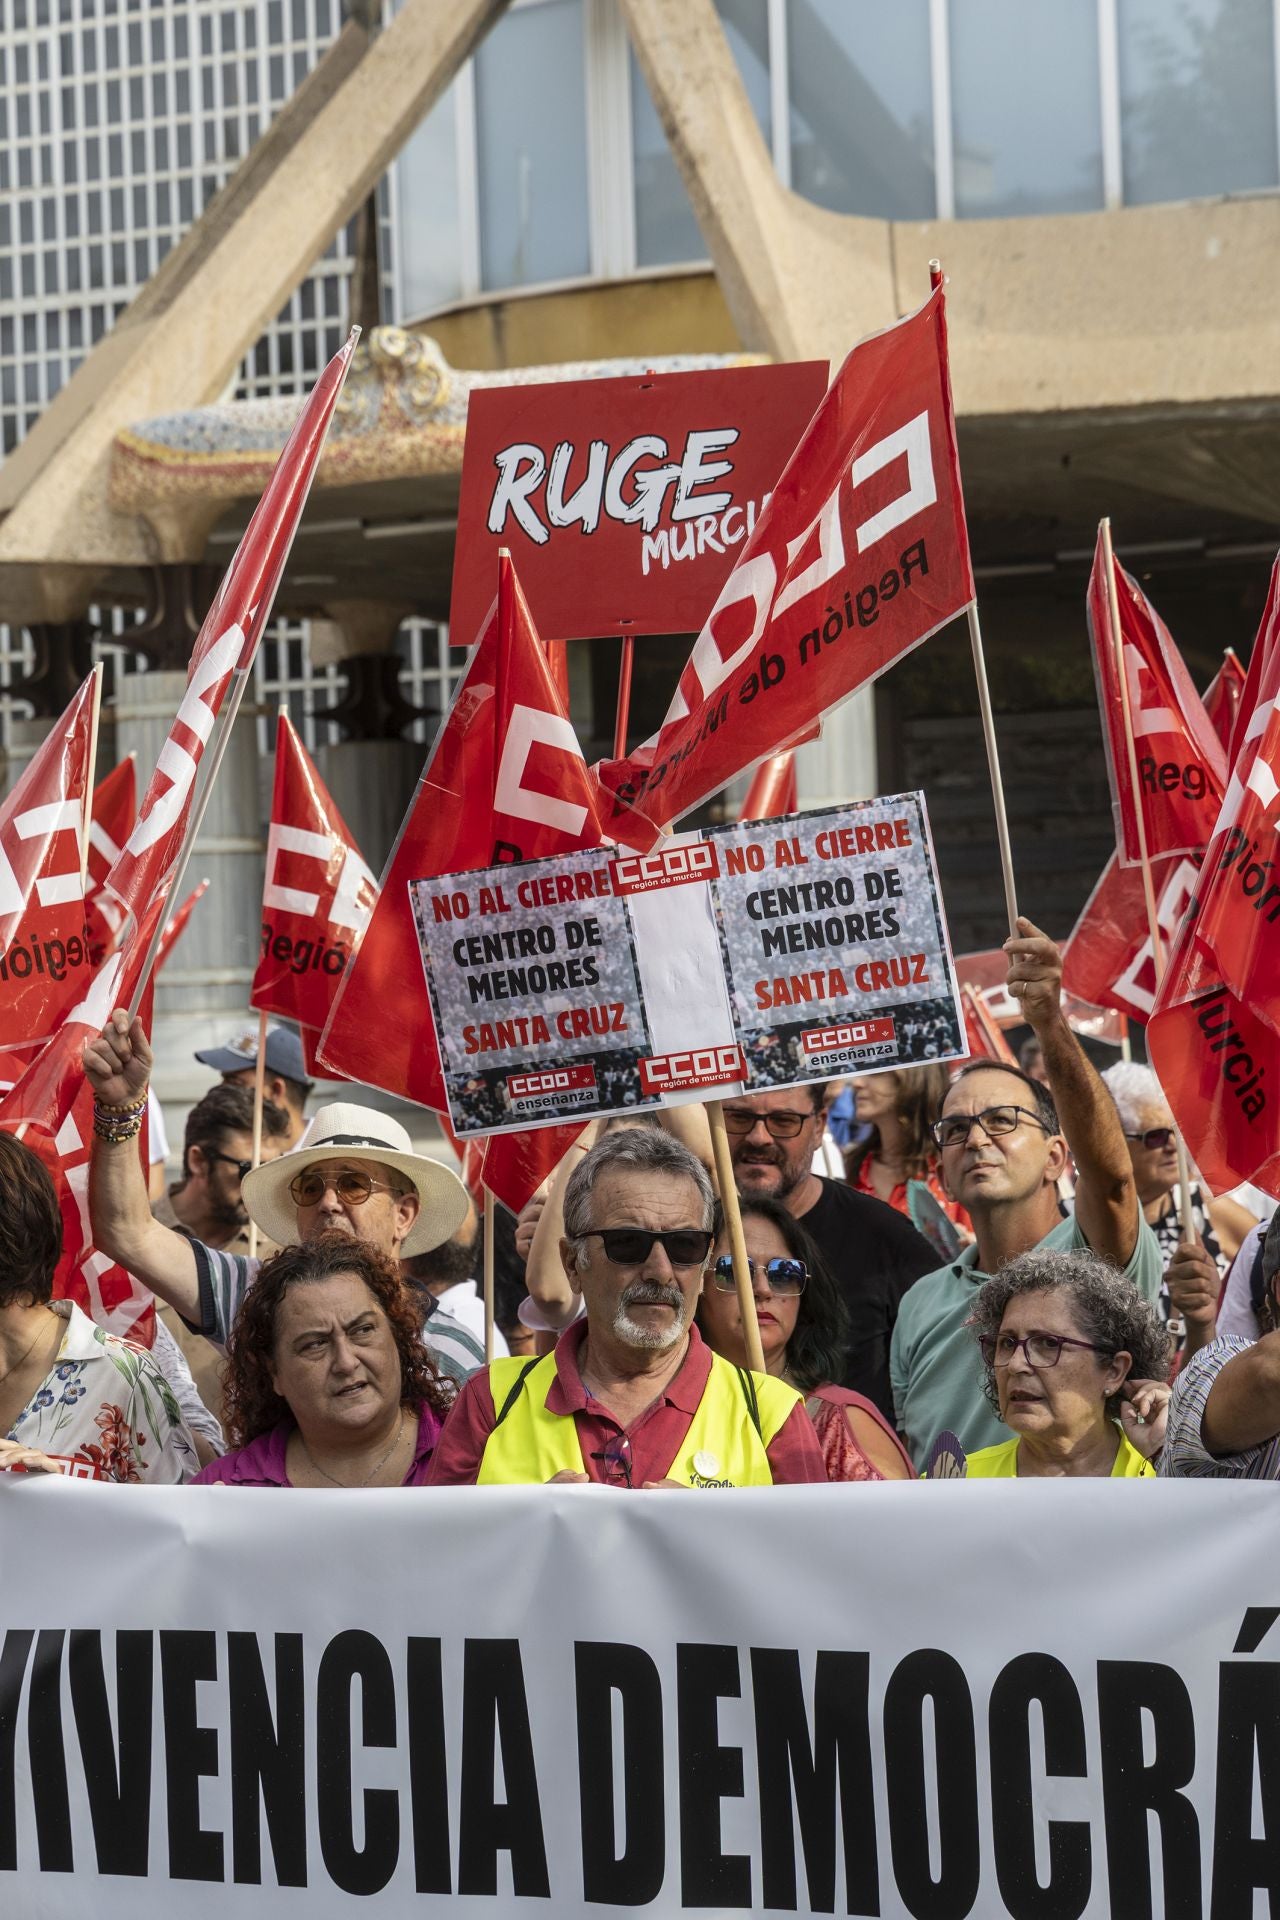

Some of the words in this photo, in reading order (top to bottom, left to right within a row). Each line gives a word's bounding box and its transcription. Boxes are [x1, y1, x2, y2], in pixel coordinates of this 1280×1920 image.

[488, 428, 740, 546] RUGE
[641, 493, 773, 577] MURCI
[1138, 756, 1216, 801] Reg
[615, 845, 713, 885] CCOO
[724, 844, 765, 877] NO
[775, 838, 808, 868] AL
[815, 818, 912, 860] CIERRE
[431, 892, 470, 923] NO
[479, 886, 511, 916] AL
[517, 868, 611, 909] CIERRE
[631, 879, 659, 890] región
[660, 877, 671, 885] de
[673, 871, 702, 882] murcia
[746, 876, 855, 921] CENTRO
[863, 868, 903, 901] DE
[452, 925, 556, 968] CENTRO
[564, 917, 602, 950] DE
[761, 907, 900, 957] MENORES
[467, 955, 600, 1004] MENORES
[754, 968, 849, 1011] SANTA
[854, 953, 930, 993] CRUZ
[462, 1015, 551, 1055] SANTA
[556, 1002, 628, 1040] CRUZ
[806, 1025, 867, 1049] CCOO
[645, 1047, 741, 1083] CCOO
[811, 1043, 893, 1066] enseñanza
[512, 1072, 569, 1094] CCOO
[516, 1089, 594, 1111] enseñanza
[660, 1078, 687, 1089] región
[689, 1076, 699, 1084] de
[702, 1072, 731, 1082] murcia
